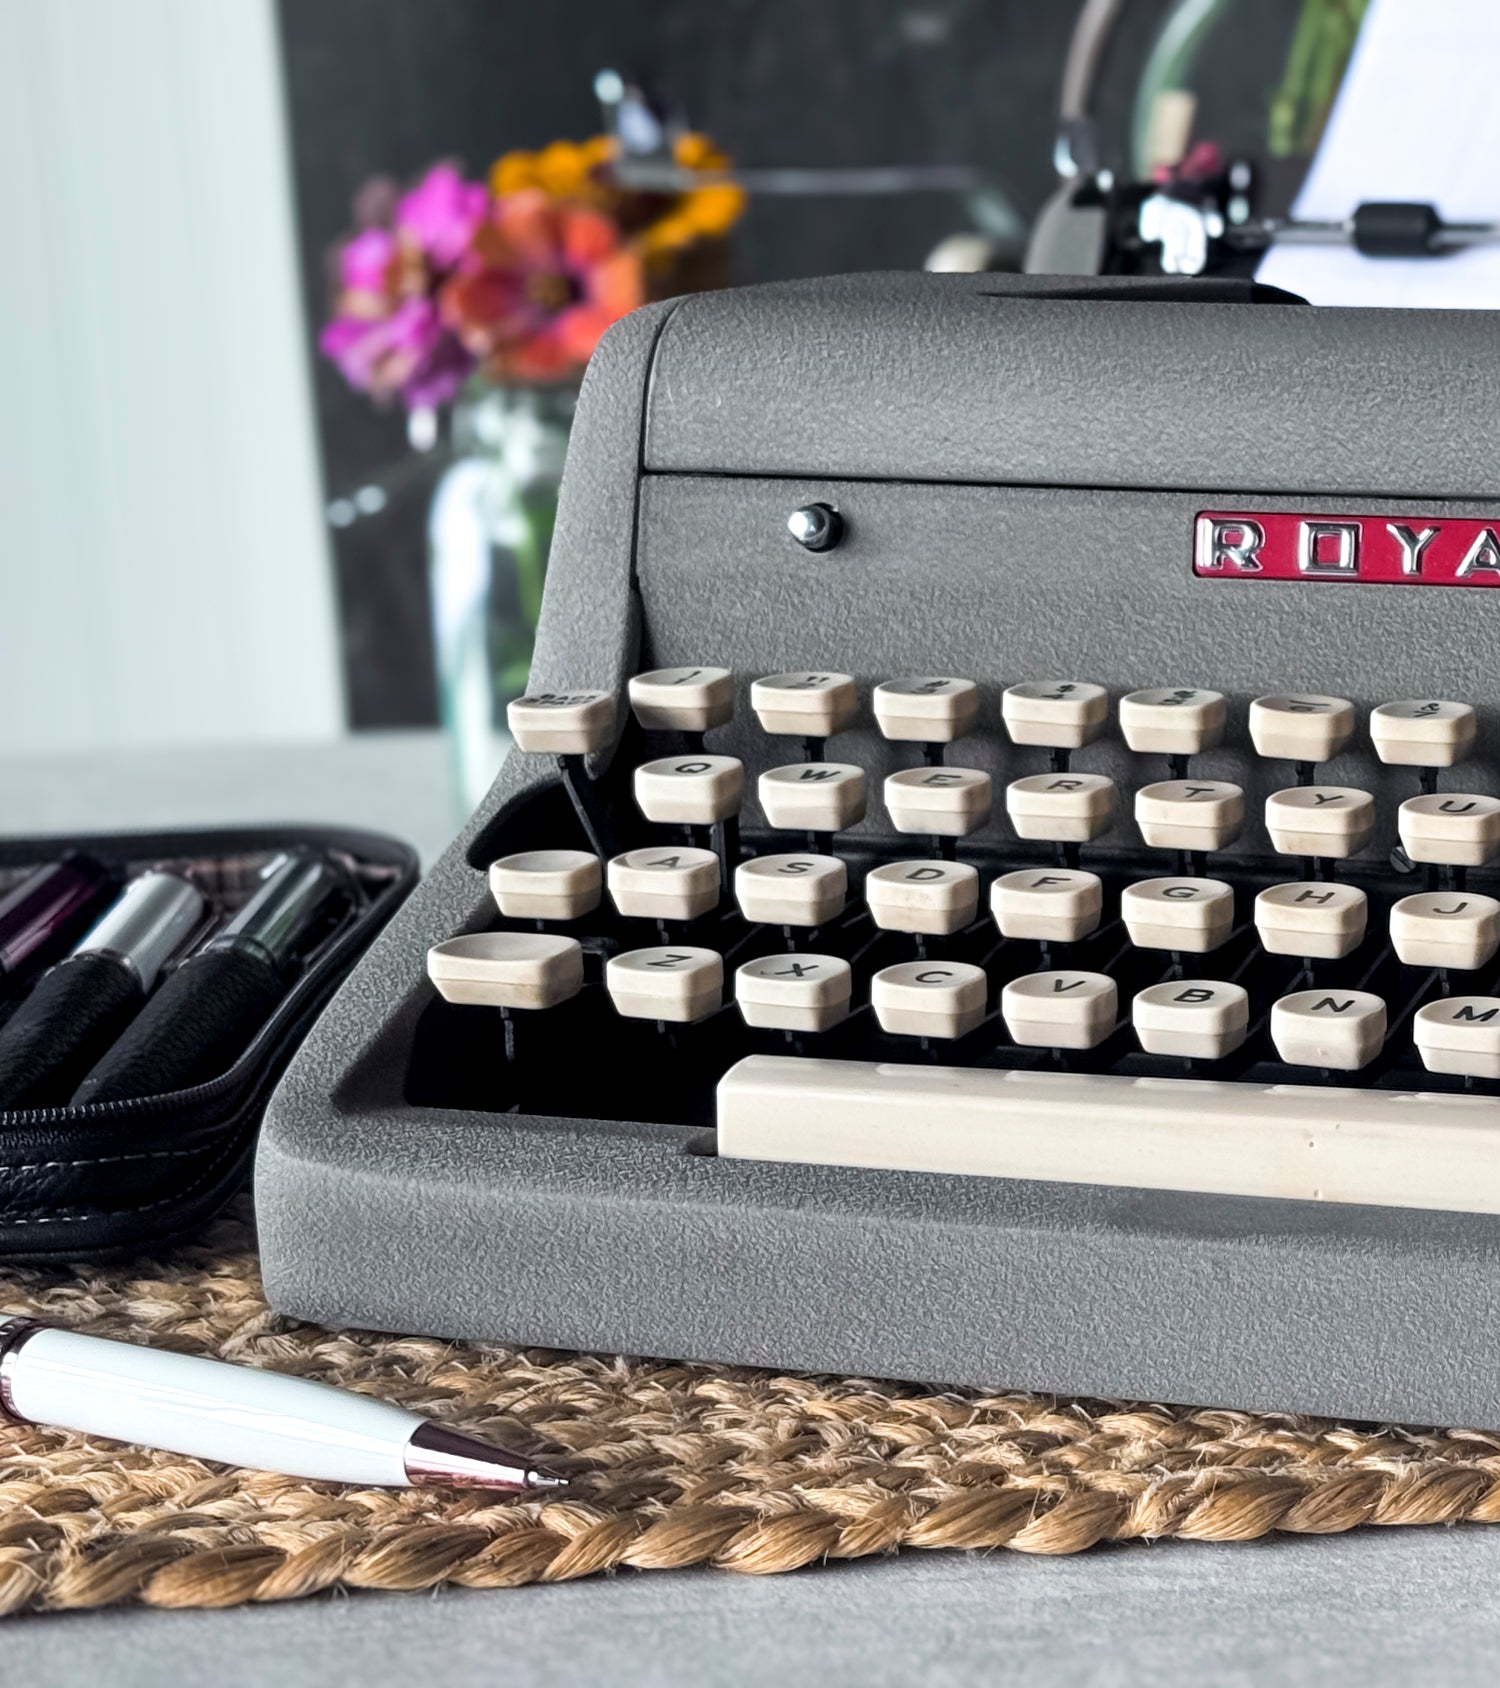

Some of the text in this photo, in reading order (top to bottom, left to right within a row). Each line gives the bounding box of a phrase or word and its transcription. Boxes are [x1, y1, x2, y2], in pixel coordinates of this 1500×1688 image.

[539, 693, 597, 701] BACK
[674, 763, 712, 773] Q
[799, 769, 841, 782] W
[921, 774, 963, 785] E
[1046, 780, 1084, 792] R
[1185, 787, 1214, 798] T
[1315, 794, 1344, 805] Y
[1439, 801, 1476, 812] U
[646, 856, 680, 869] A
[777, 862, 814, 873] S
[905, 868, 945, 880] D
[1030, 877, 1071, 888] F
[1162, 887, 1199, 898] G
[1294, 890, 1335, 904] H
[1432, 902, 1468, 914] J
[646, 954, 692, 967] Z
[775, 963, 819, 977] X
[915, 971, 953, 983] C
[1054, 979, 1087, 993] V
[1173, 989, 1214, 1002] B
[1311, 998, 1355, 1012] N
[1452, 1006, 1499, 1022] M
